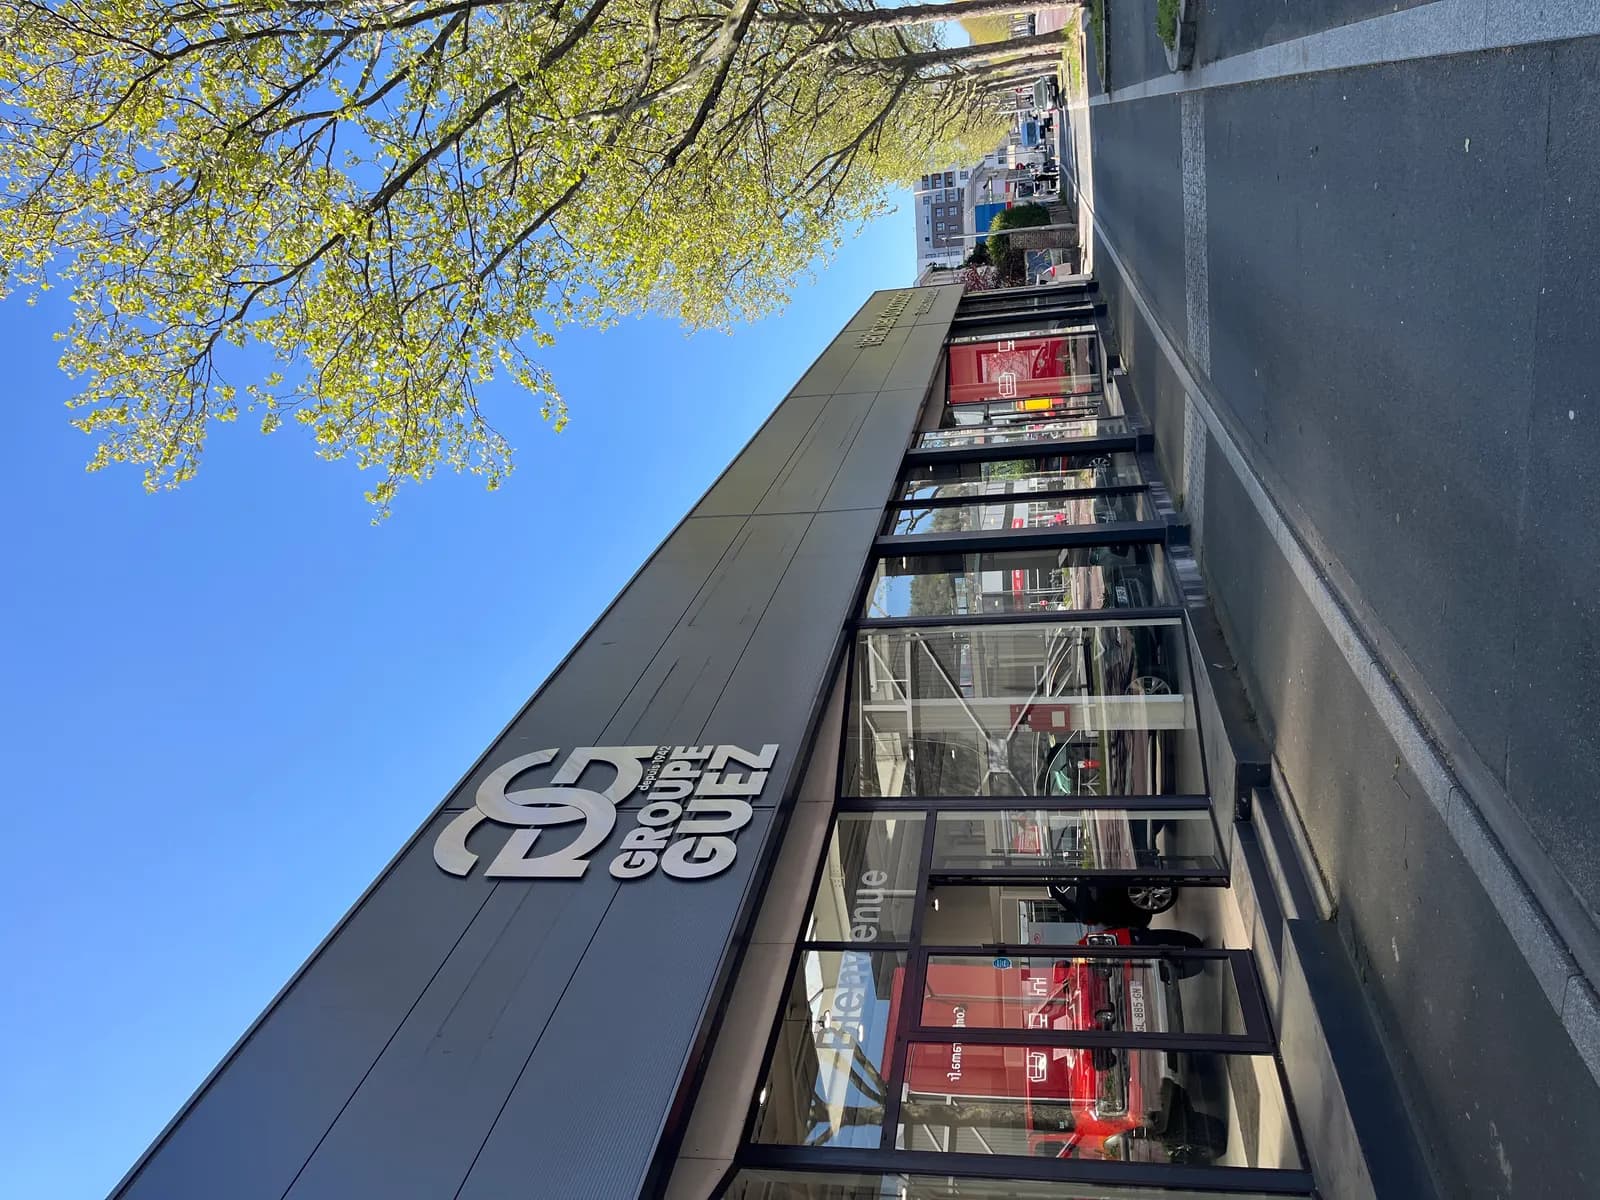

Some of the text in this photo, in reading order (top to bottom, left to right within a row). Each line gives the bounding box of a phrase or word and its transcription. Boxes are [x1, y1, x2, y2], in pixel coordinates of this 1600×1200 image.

[608, 745, 714, 878] GROUPE
[638, 745, 672, 791] depuis 1942
[660, 744, 779, 878] GUEZ
